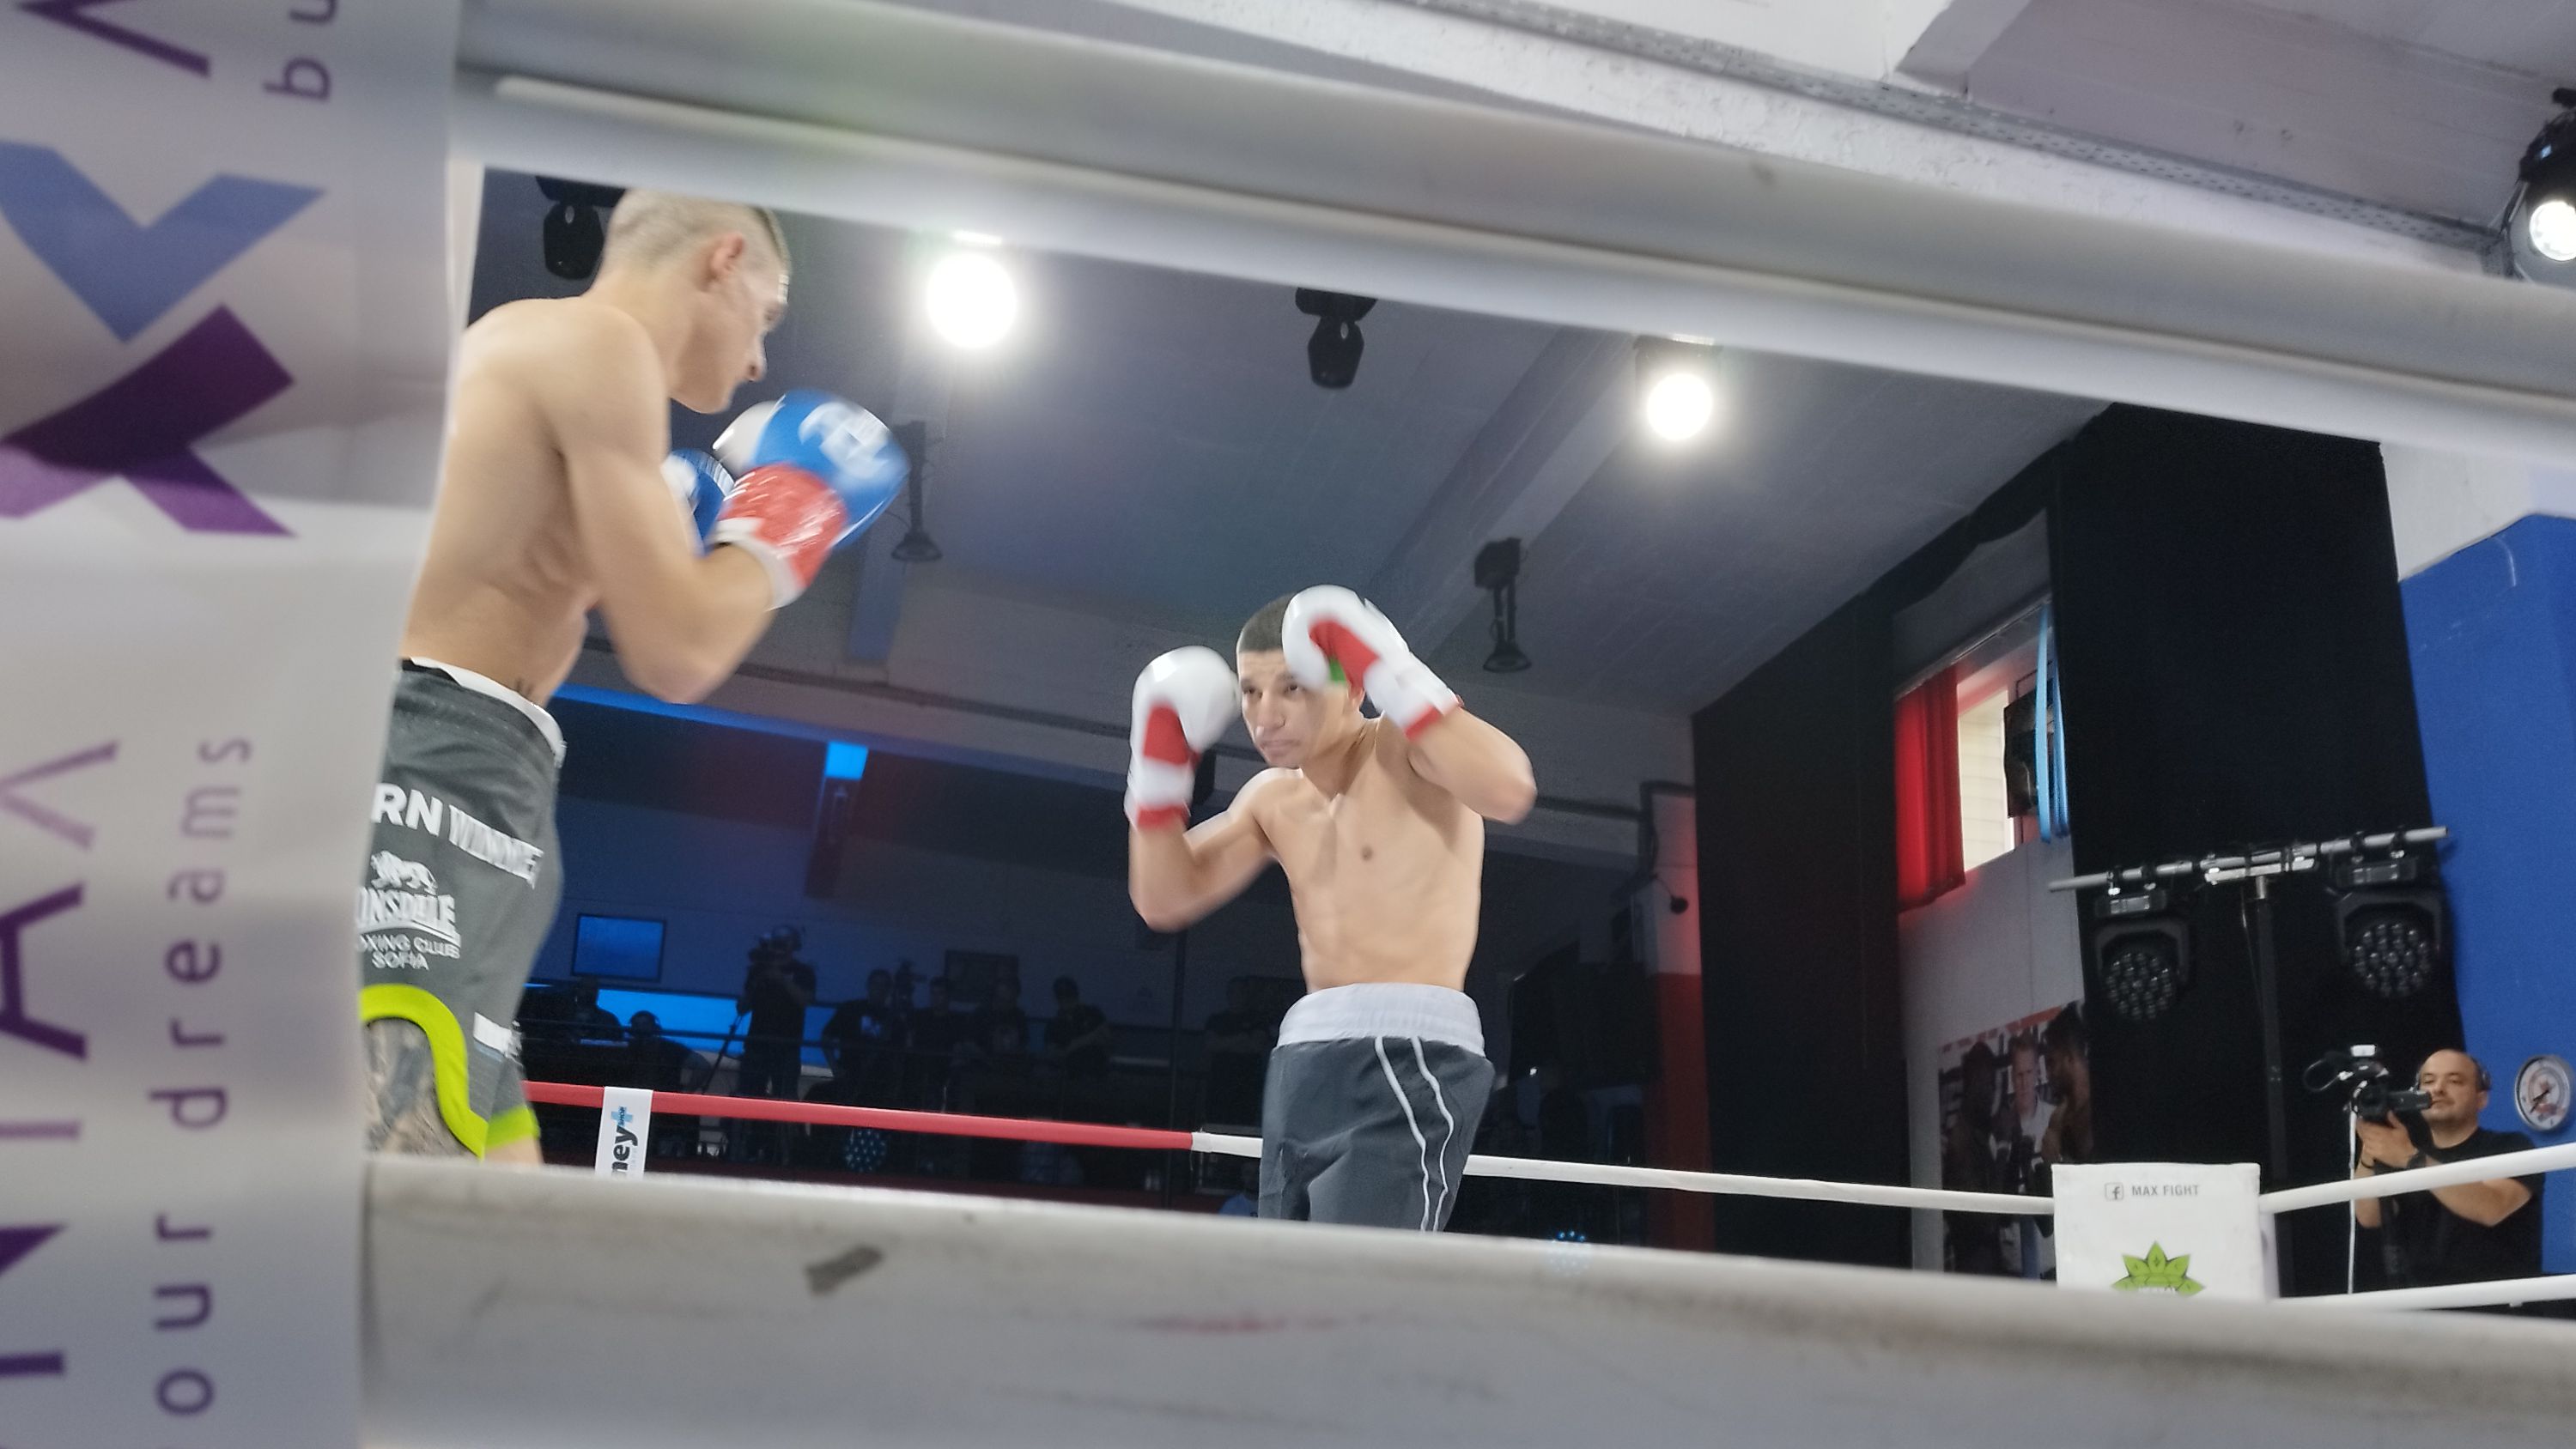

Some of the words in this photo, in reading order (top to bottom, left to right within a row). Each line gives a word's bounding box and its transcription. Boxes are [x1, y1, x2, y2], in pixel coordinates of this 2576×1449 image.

[148, 738, 252, 1131] dreams
[371, 950, 429, 971] SOFIA
[2131, 1185, 2159, 1197] MAX
[2162, 1185, 2199, 1197] FIGHT
[155, 1210, 215, 1418] our
